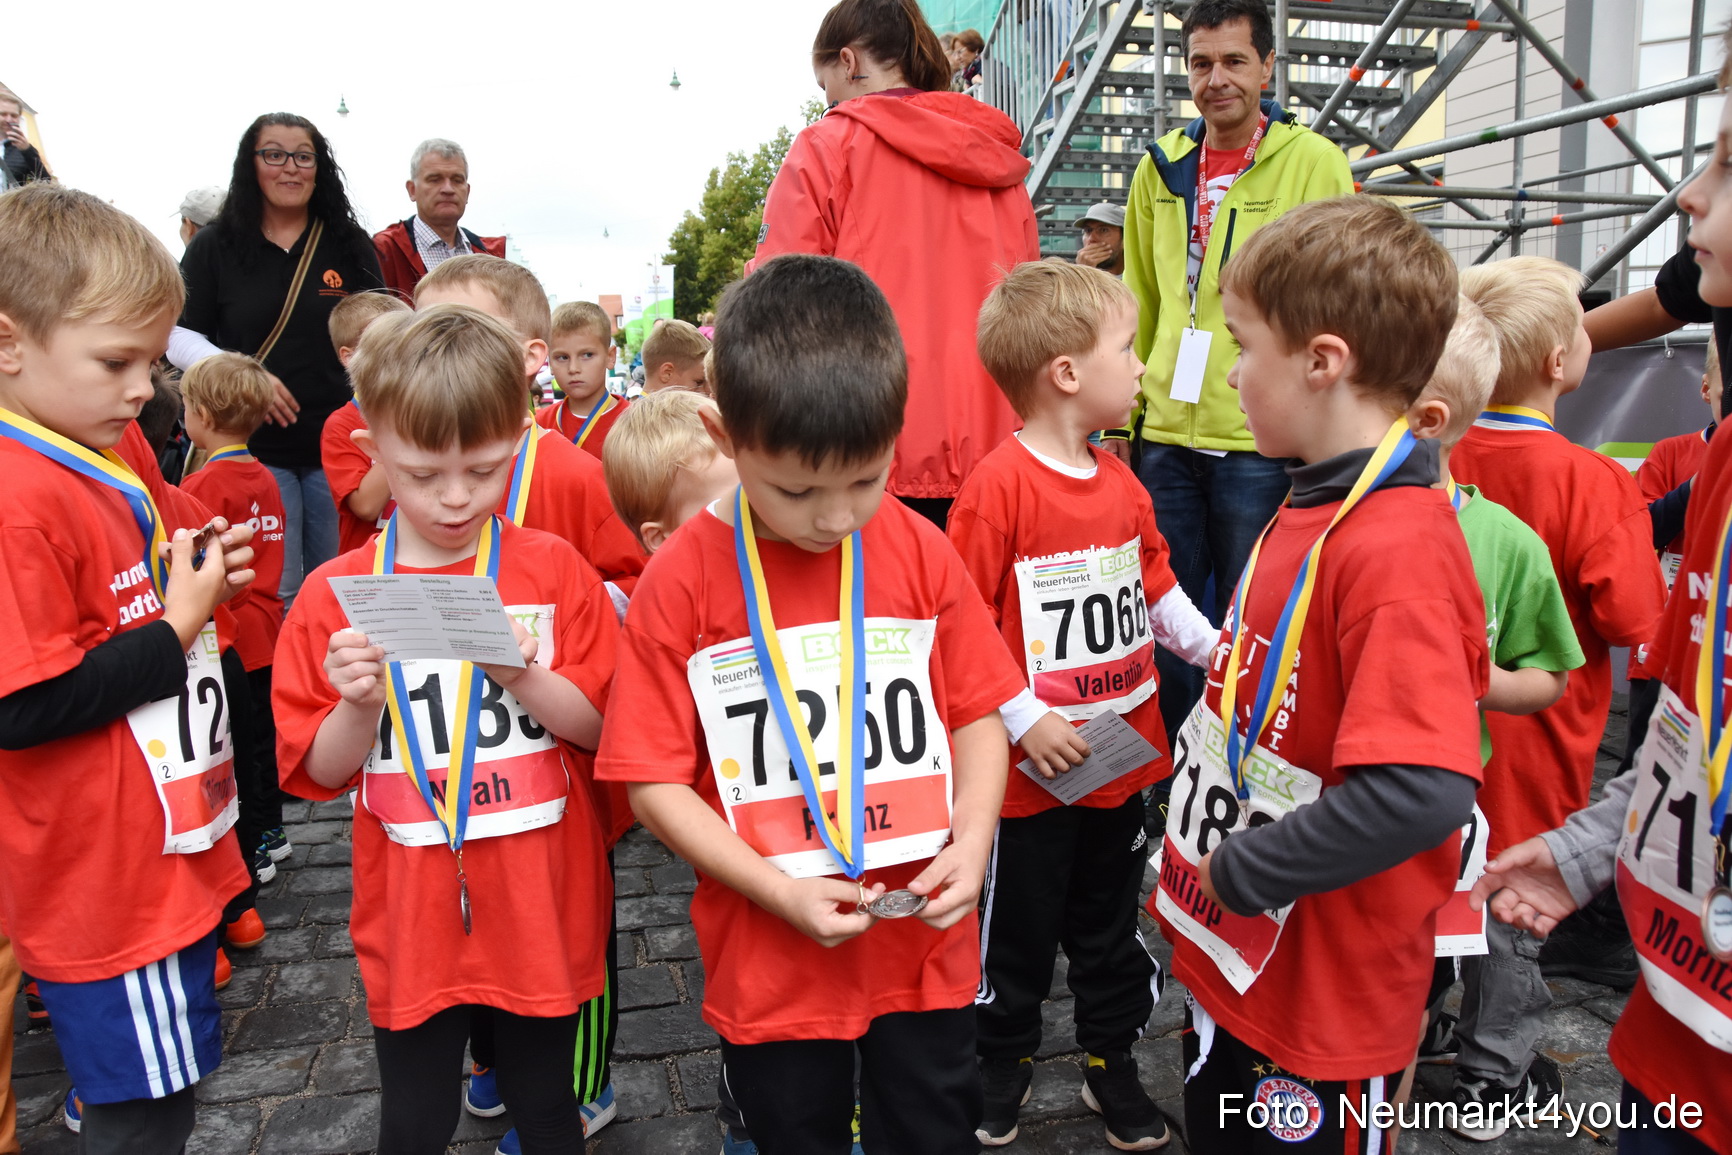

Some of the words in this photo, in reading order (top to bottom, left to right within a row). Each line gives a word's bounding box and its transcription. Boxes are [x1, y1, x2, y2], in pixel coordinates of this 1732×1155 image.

[1033, 573, 1091, 589] NeuerMarkt
[1041, 579, 1146, 660] 7066
[802, 628, 912, 662] BCK
[712, 664, 763, 686] NeuerM
[1036, 660, 1043, 671] 2
[1075, 660, 1142, 698] Valentin
[150, 676, 233, 763] 72
[162, 765, 171, 779] 2
[932, 755, 942, 770] K
[429, 772, 512, 807] Nah
[733, 787, 743, 801] 2
[802, 803, 892, 841] Frnz
[1635, 761, 1732, 893] 71
[1270, 1080, 1317, 1108] BAYERN
